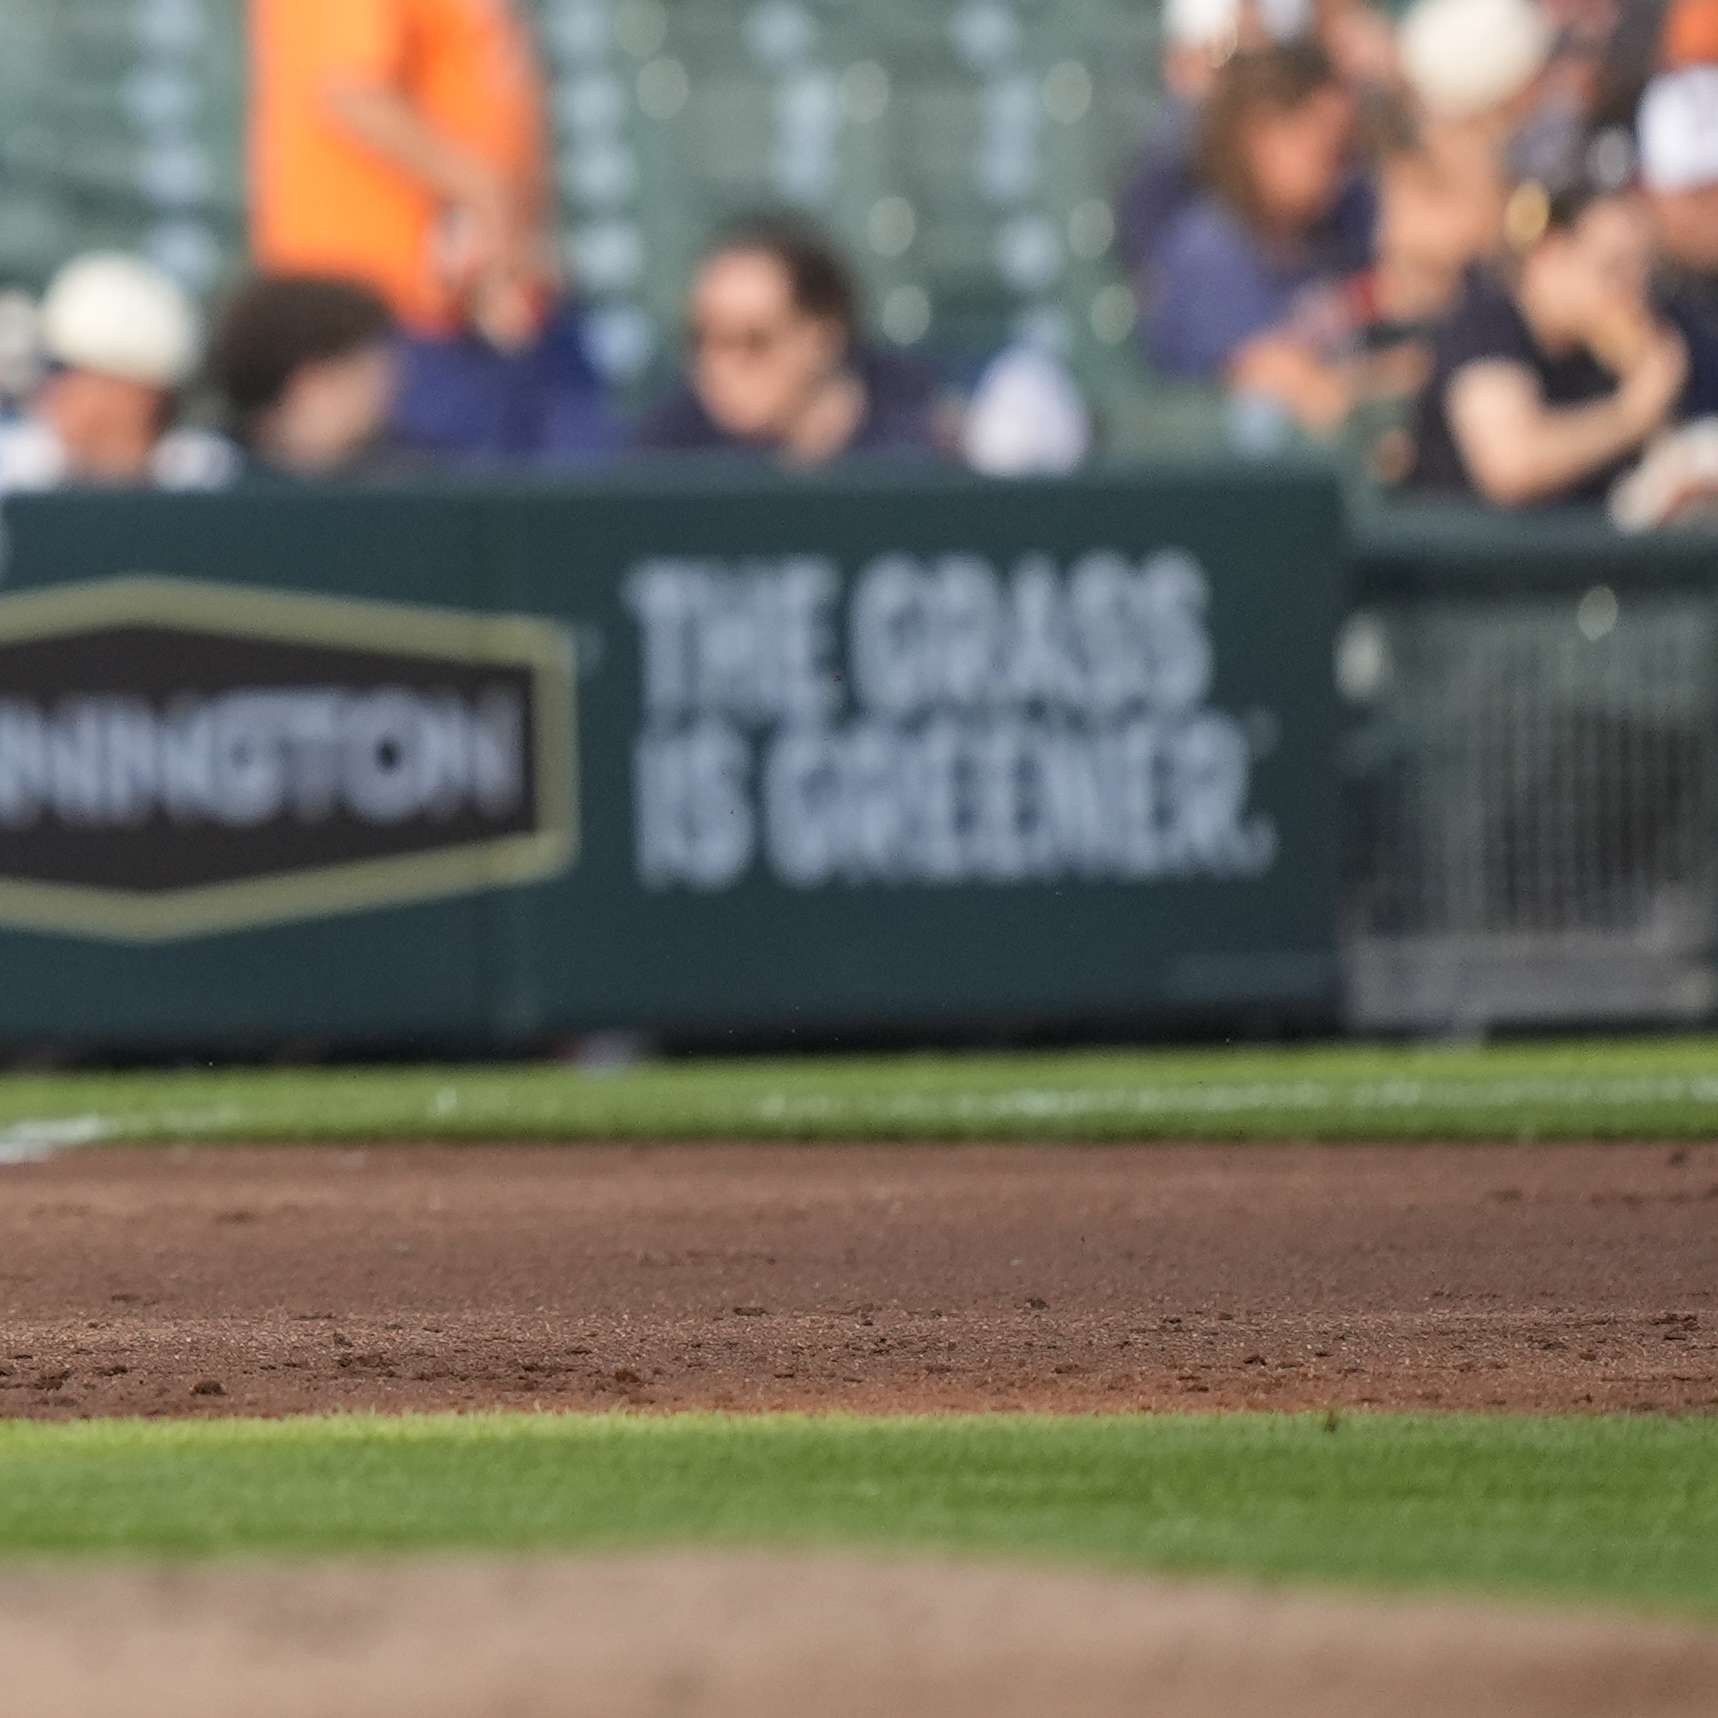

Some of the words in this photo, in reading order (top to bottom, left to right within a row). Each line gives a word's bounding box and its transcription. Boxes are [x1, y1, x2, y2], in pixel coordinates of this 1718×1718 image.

[624, 552, 842, 714] THE
[850, 547, 1212, 708] GRASS
[632, 714, 756, 890] IS
